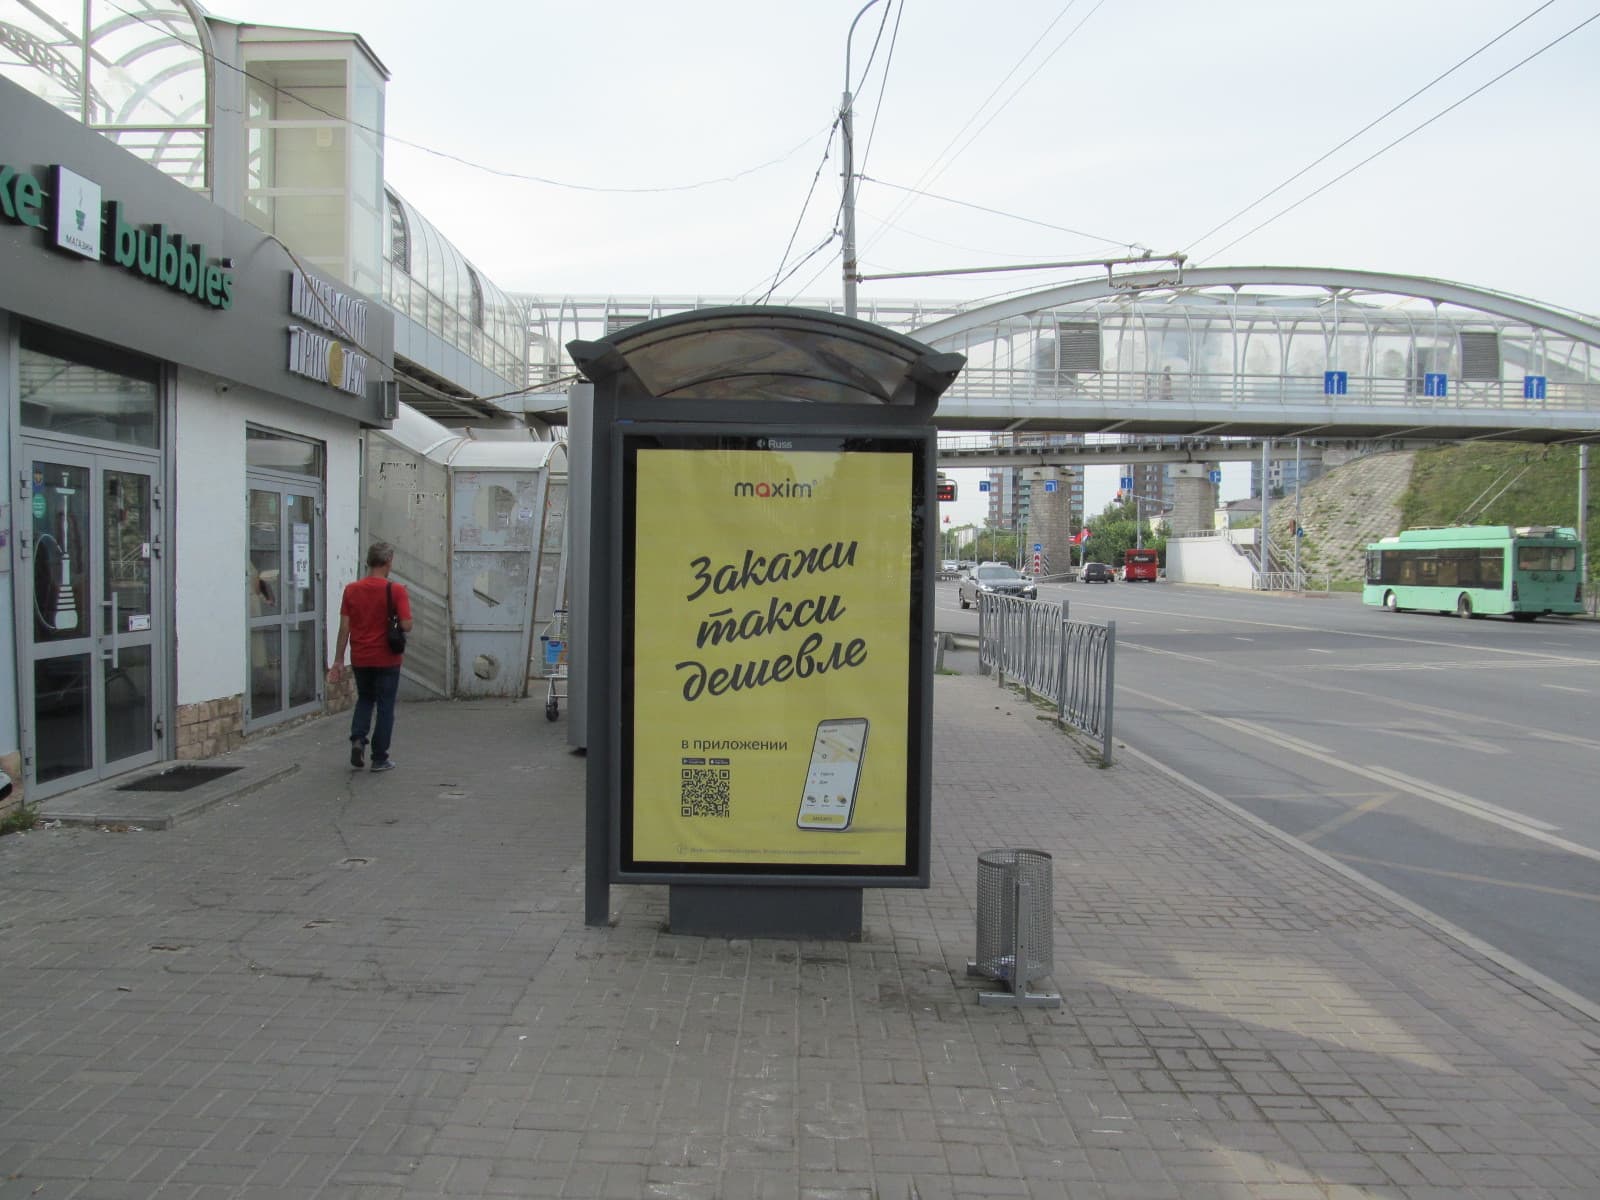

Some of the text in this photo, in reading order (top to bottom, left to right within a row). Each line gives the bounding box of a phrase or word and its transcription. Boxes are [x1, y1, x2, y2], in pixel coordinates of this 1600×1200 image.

[114, 200, 233, 310] bubbles
[734, 478, 812, 498] maxim
[687, 540, 858, 602] Закажи
[696, 594, 846, 649] такси
[675, 632, 868, 702] дешевле
[681, 739, 788, 753] в приложении
